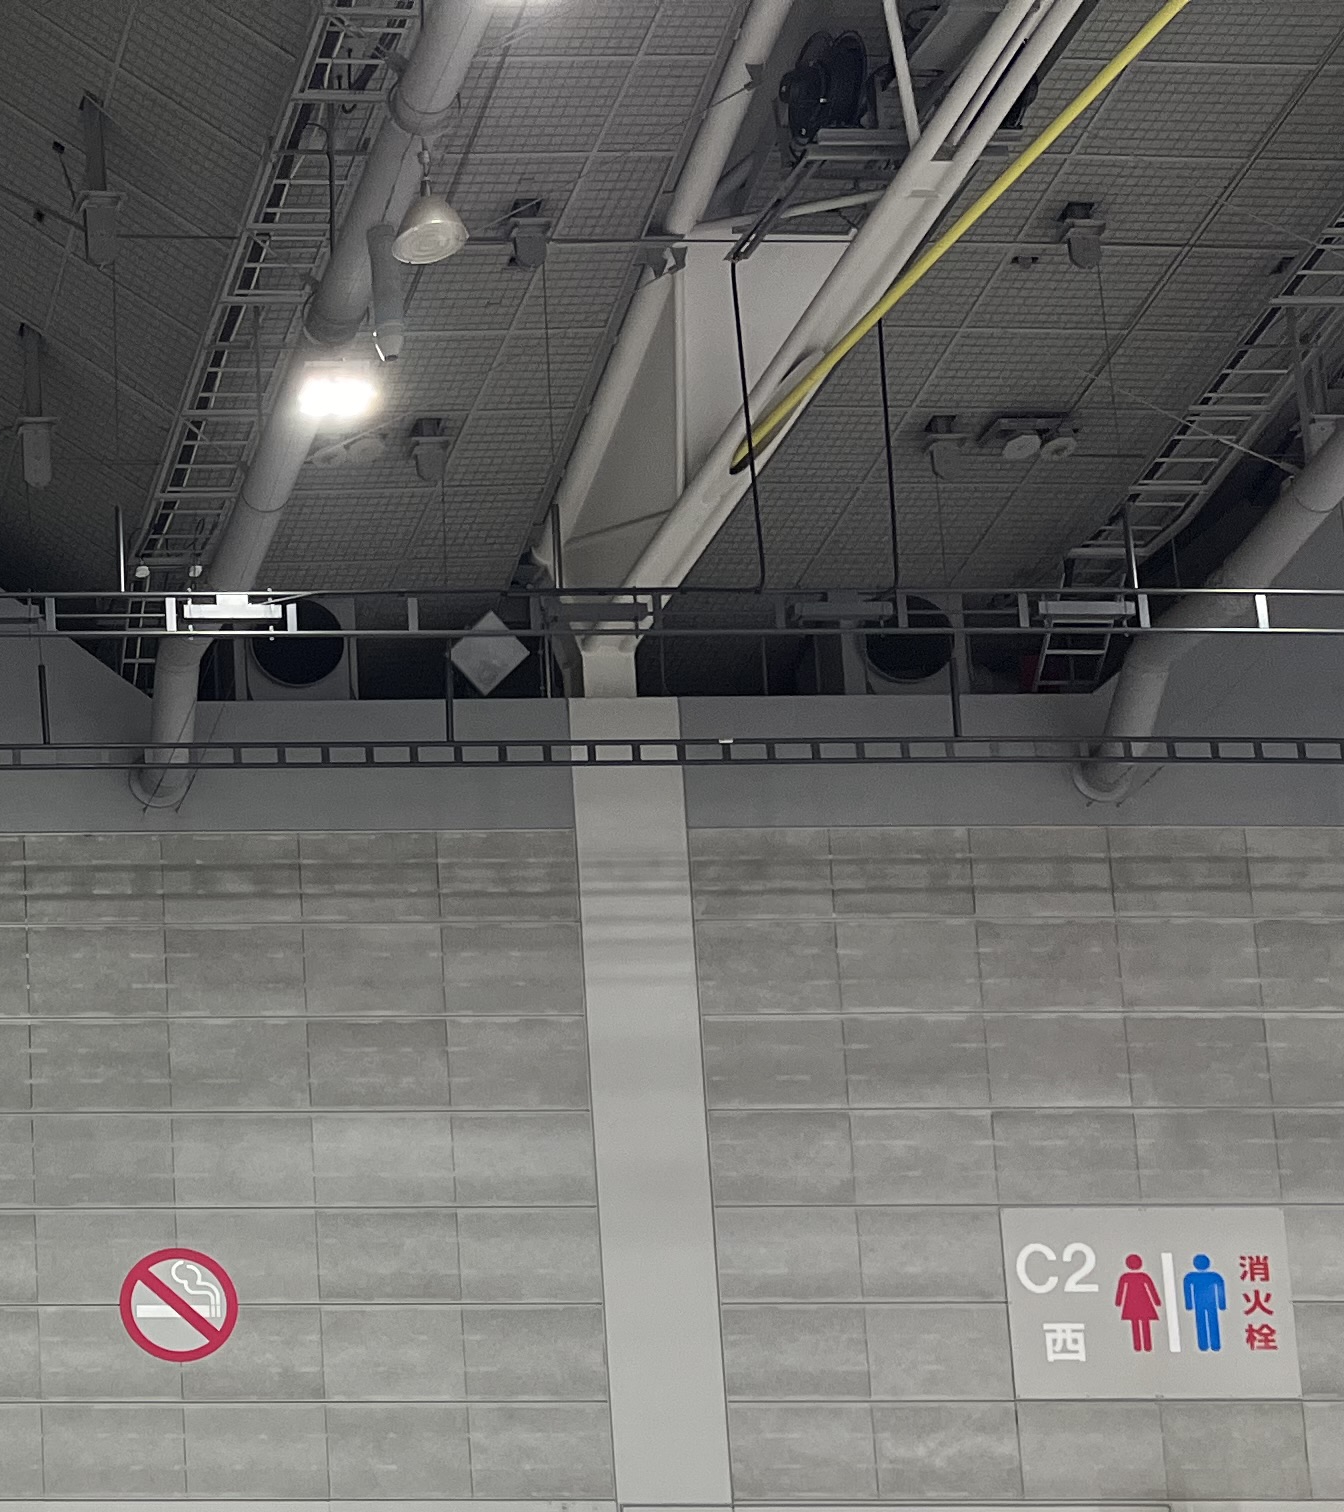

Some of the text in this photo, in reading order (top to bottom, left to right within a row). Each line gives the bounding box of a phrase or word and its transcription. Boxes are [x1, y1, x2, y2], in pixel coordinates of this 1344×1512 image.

[1016, 1242, 1099, 1294] C2
[1238, 1254, 1279, 1351] 消火栓
[1043, 1322, 1087, 1362] 西
